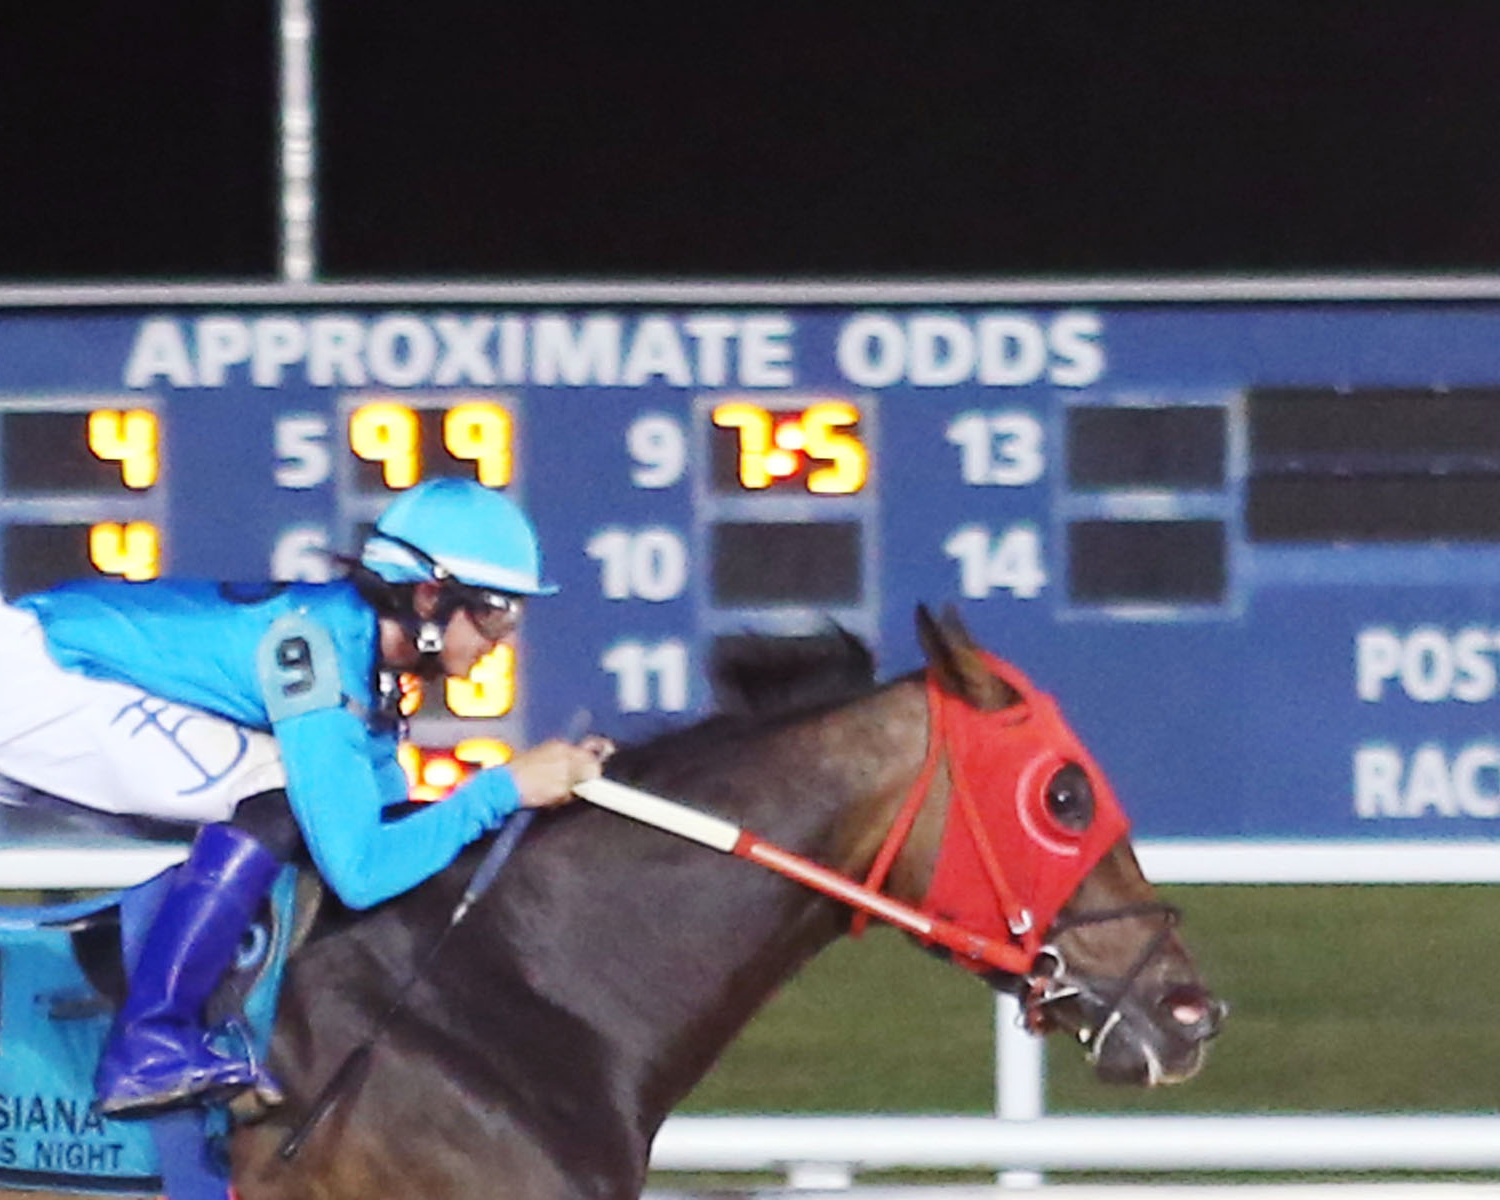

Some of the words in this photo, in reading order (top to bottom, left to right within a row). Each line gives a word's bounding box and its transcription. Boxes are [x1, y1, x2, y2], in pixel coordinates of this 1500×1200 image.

[124, 316, 795, 388] APPROXIMATE
[836, 316, 1106, 386] ODDS
[88, 408, 160, 489] 4
[273, 416, 330, 488] 5
[628, 416, 686, 488] 9
[946, 414, 1046, 486] 13
[587, 529, 686, 602] 10
[943, 528, 1047, 599] 14
[276, 637, 315, 696] 9
[605, 643, 688, 713] 11
[1356, 627, 1500, 702] POS
[34, 1140, 124, 1170] NIGHT
